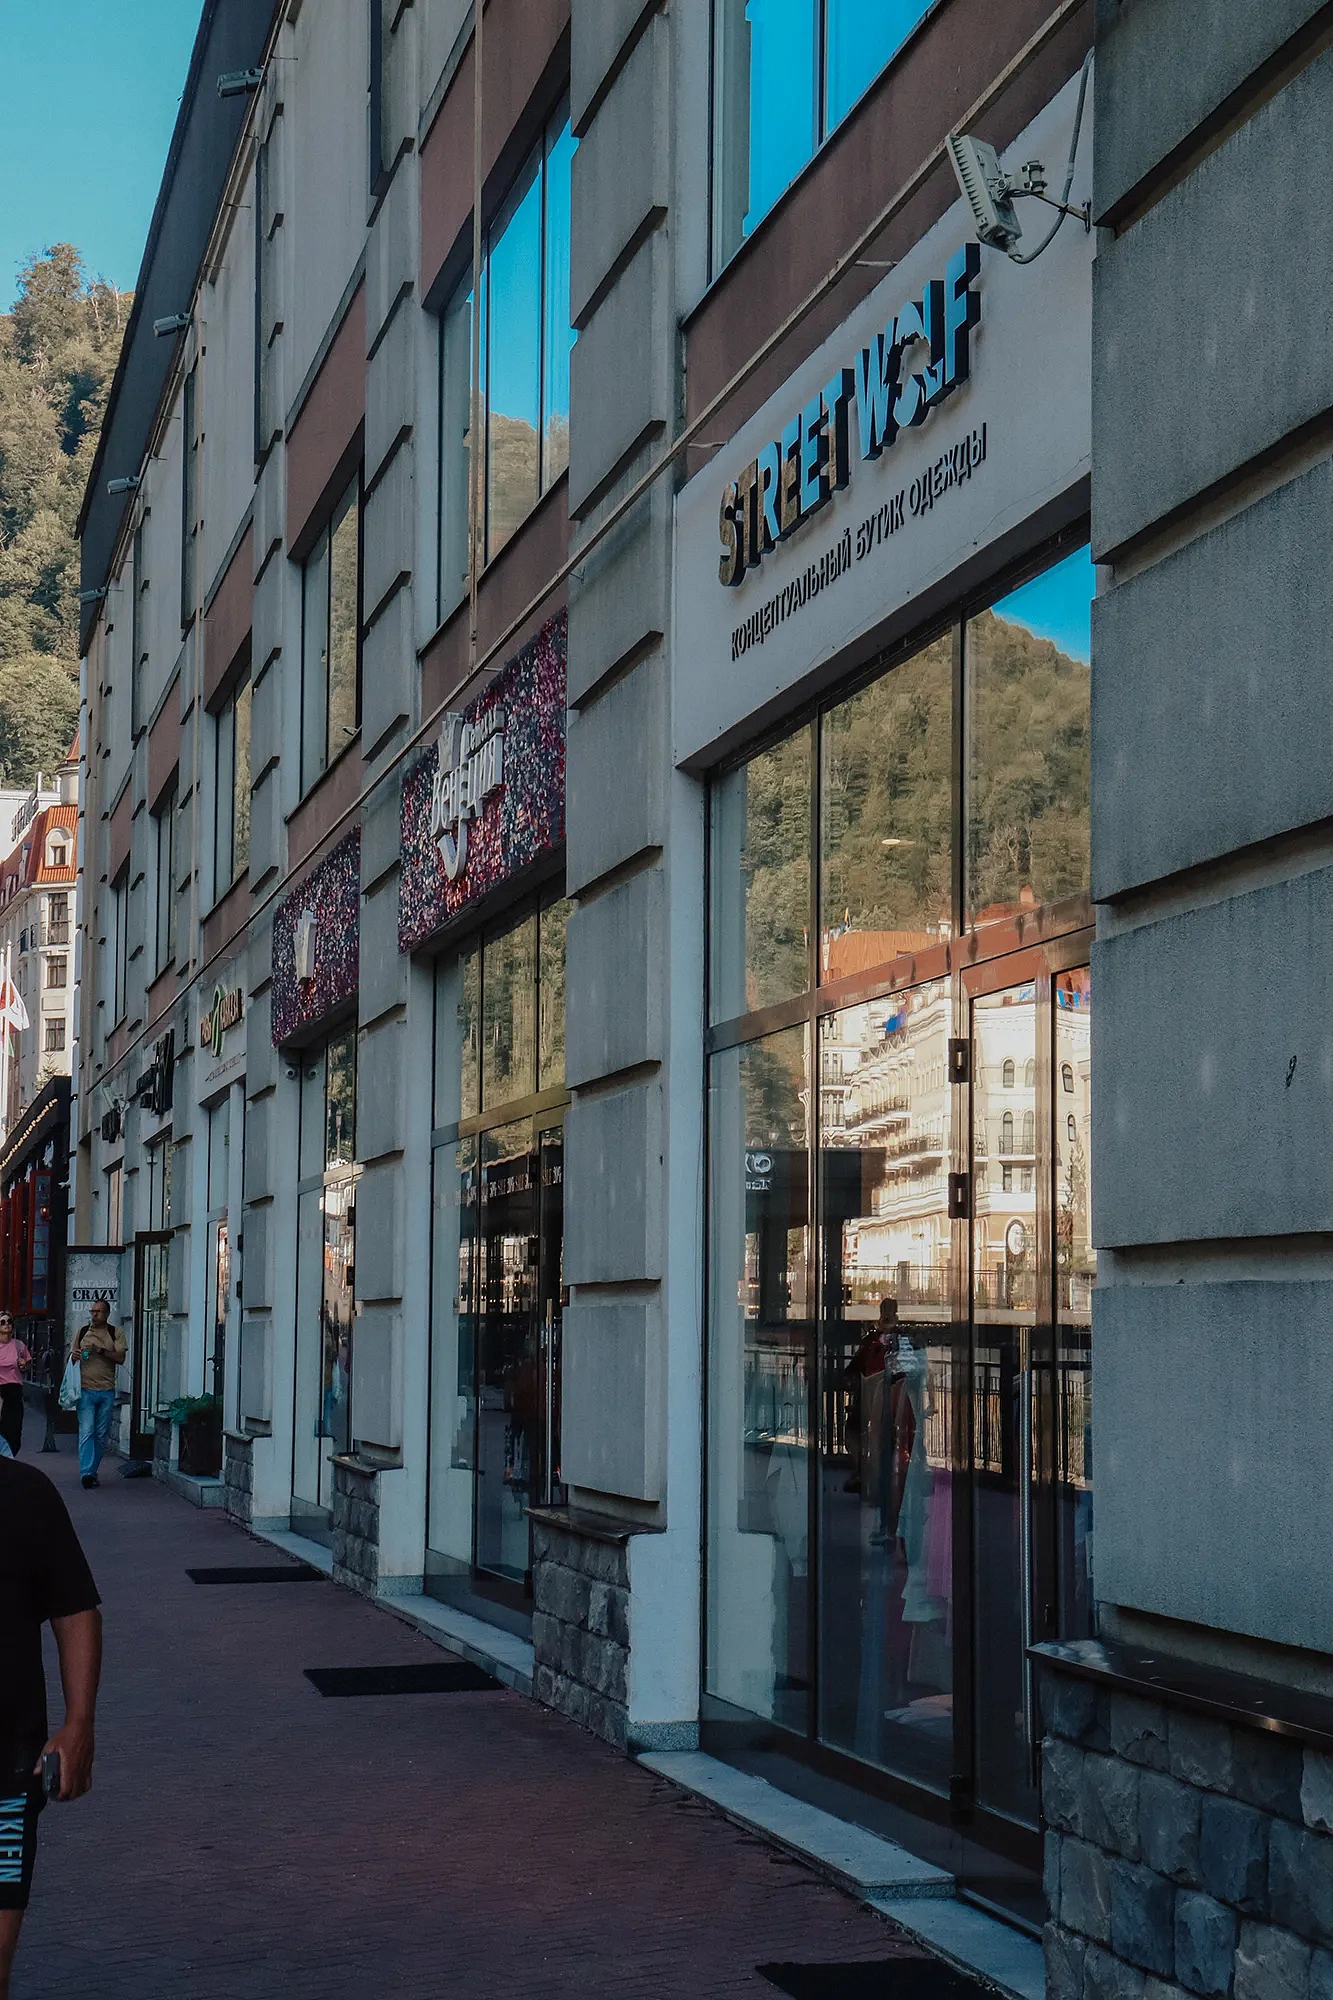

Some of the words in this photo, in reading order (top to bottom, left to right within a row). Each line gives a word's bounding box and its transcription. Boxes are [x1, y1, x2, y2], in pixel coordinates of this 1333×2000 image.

[718, 368, 855, 587] STREET
[855, 242, 981, 461] WOLF
[731, 527, 851, 661] КОНЦЕПТУАЛЬНЫЙ
[856, 490, 905, 561] БУТИК
[909, 422, 987, 517] ОДЕЖДЫ
[72, 1289, 117, 1300] CRAZY
[72, 1302, 118, 1312] ШАК
